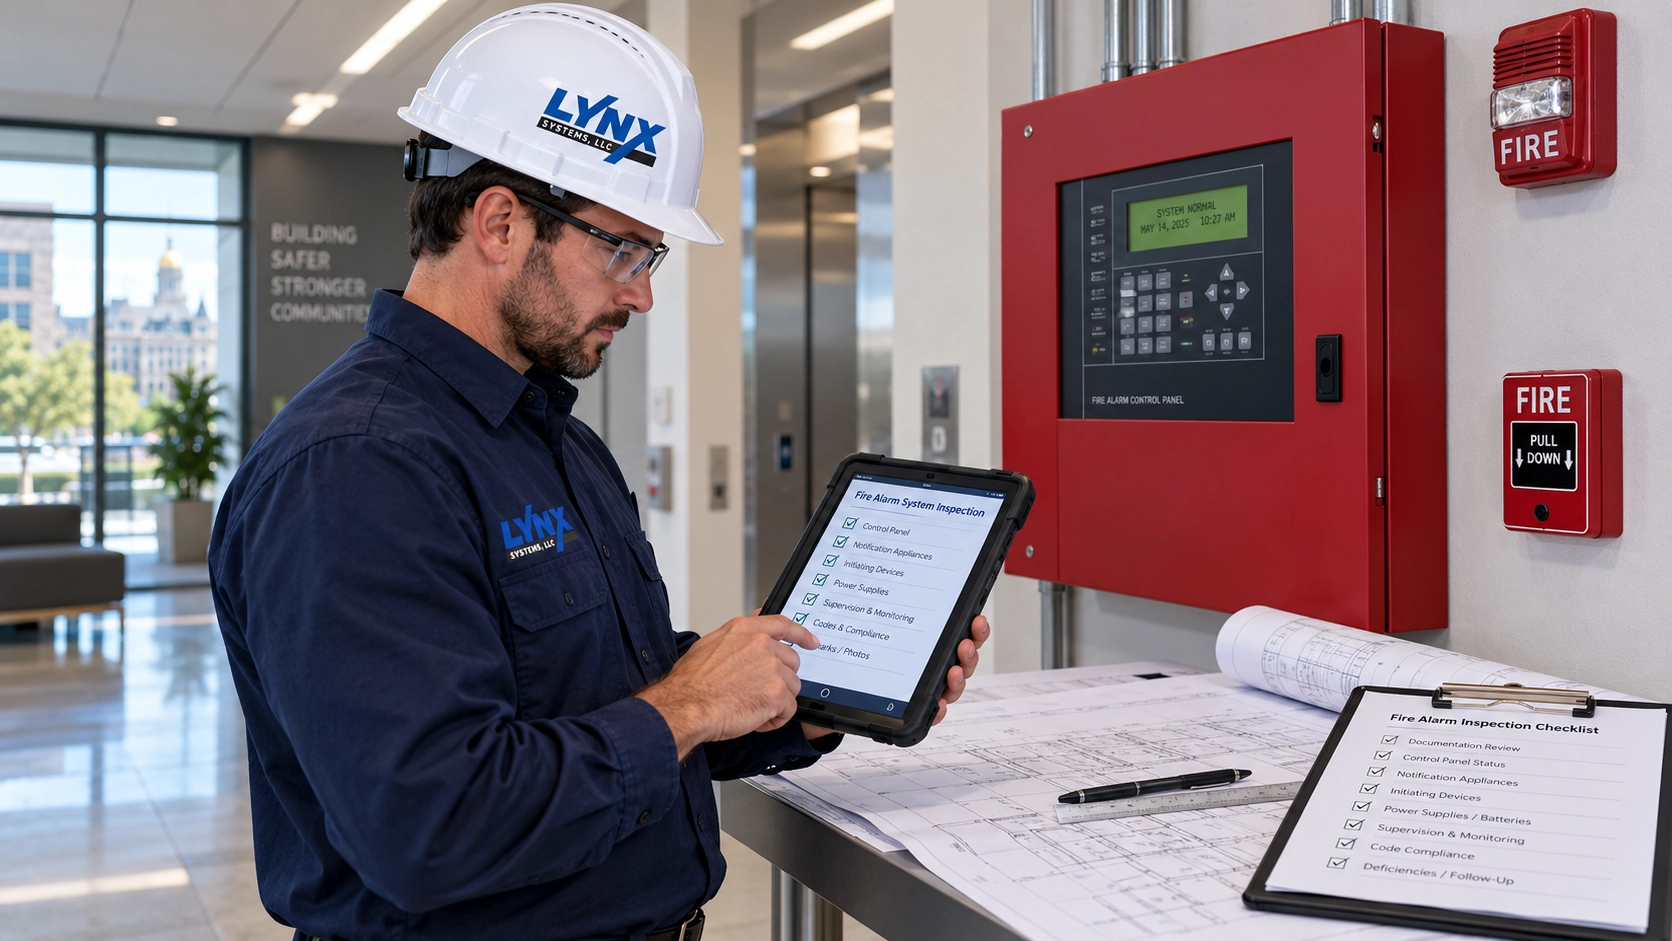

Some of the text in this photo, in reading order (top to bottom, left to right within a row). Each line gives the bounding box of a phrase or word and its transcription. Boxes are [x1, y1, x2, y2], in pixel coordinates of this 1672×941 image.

[541, 119, 613, 151] SYSTEMS, LLC
[543, 87, 666, 165] LYNX
[1501, 129, 1559, 165] FIRE
[1157, 200, 1217, 219] SYSTEM NORMAL
[271, 222, 358, 245] BUILDING
[1140, 212, 1236, 234] MAY 14, 2025 10:27 AM
[271, 249, 331, 270] SAFER
[271, 275, 367, 298] STRONGER
[1092, 395, 1185, 405] FIRE ALARM CONTROL PANEL
[1517, 386, 1571, 414] FIRE
[1530, 434, 1558, 447] PULL
[1527, 452, 1561, 465] DOWN
[854, 490, 985, 518] Fire Alarm System Inspection
[500, 504, 574, 553] LYNX
[862, 522, 911, 536] Control Panel
[509, 539, 556, 560] SYSTEMS, LLC
[853, 541, 933, 561] Notification Appliances
[843, 560, 904, 577] Initiating Devices
[833, 579, 889, 596] Power Supplies
[823, 598, 915, 625] Supervision & Monitoring
[813, 618, 890, 641] Codes & Compliance
[837, 646, 844, 654] /
[843, 647, 871, 660] Photos
[1390, 713, 1600, 735] Fire Alarm Inspection Checklist
[1408, 738, 1521, 752] Documentation Review
[1402, 754, 1506, 768] Control Panel Status
[1396, 770, 1456, 782] Notification
[1390, 787, 1482, 802] Initiating Devices
[1383, 805, 1532, 826] Power Supplies / Batteries
[1377, 823, 1444, 838] Supervision
[1459, 832, 1525, 846] Monitoring
[1370, 842, 1475, 860] Code Compliance
[1363, 862, 1515, 886] Deficiencies / Follow-Up
